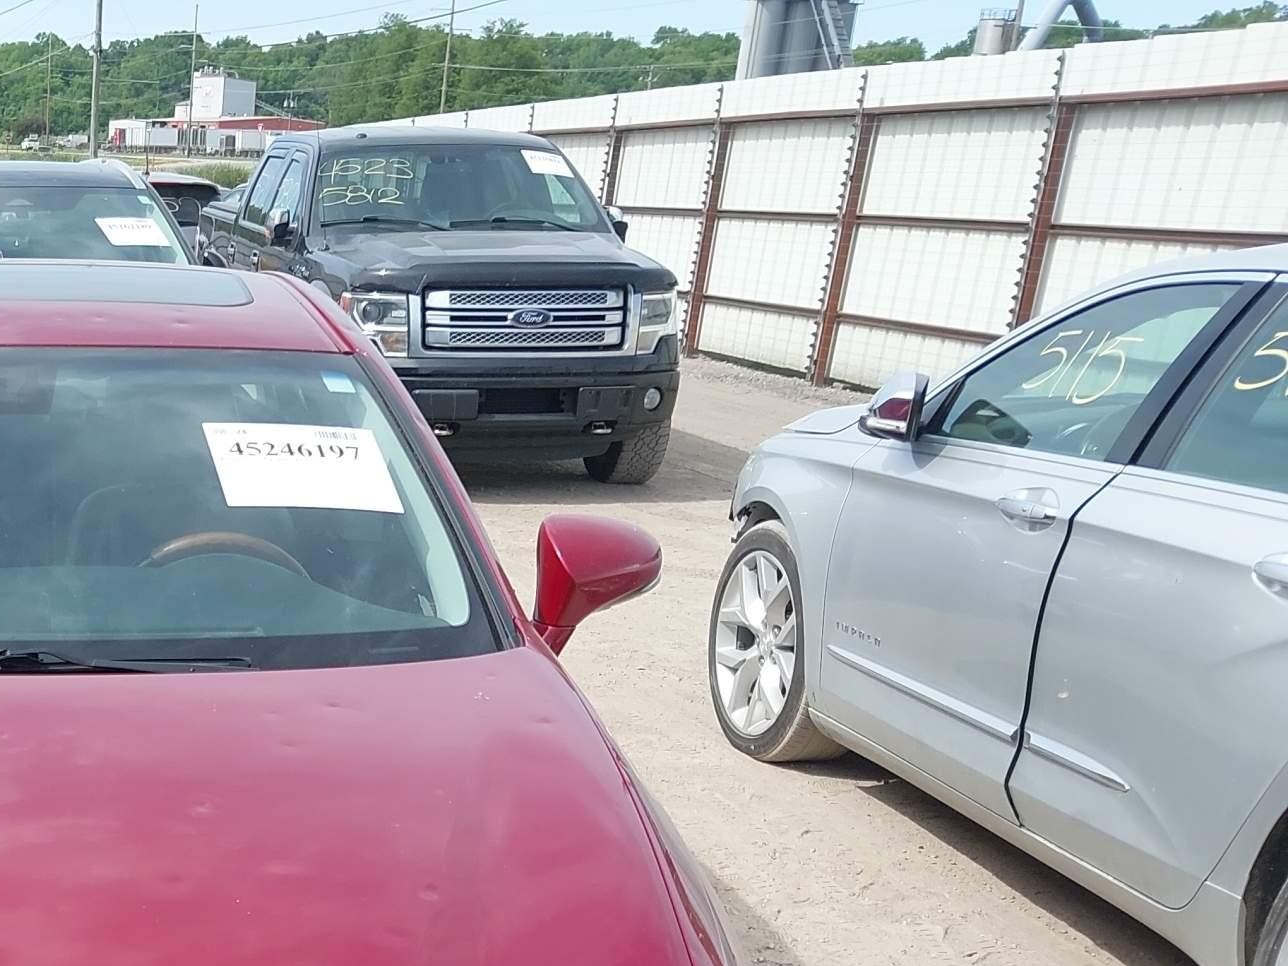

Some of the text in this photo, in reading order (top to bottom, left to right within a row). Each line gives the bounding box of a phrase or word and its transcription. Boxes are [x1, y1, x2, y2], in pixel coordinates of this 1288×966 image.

[318, 158, 413, 184] 4523
[319, 185, 405, 206] 5812
[519, 311, 544, 323] Ford
[1022, 330, 1144, 404] 5115
[228, 441, 359, 461] 45246197
